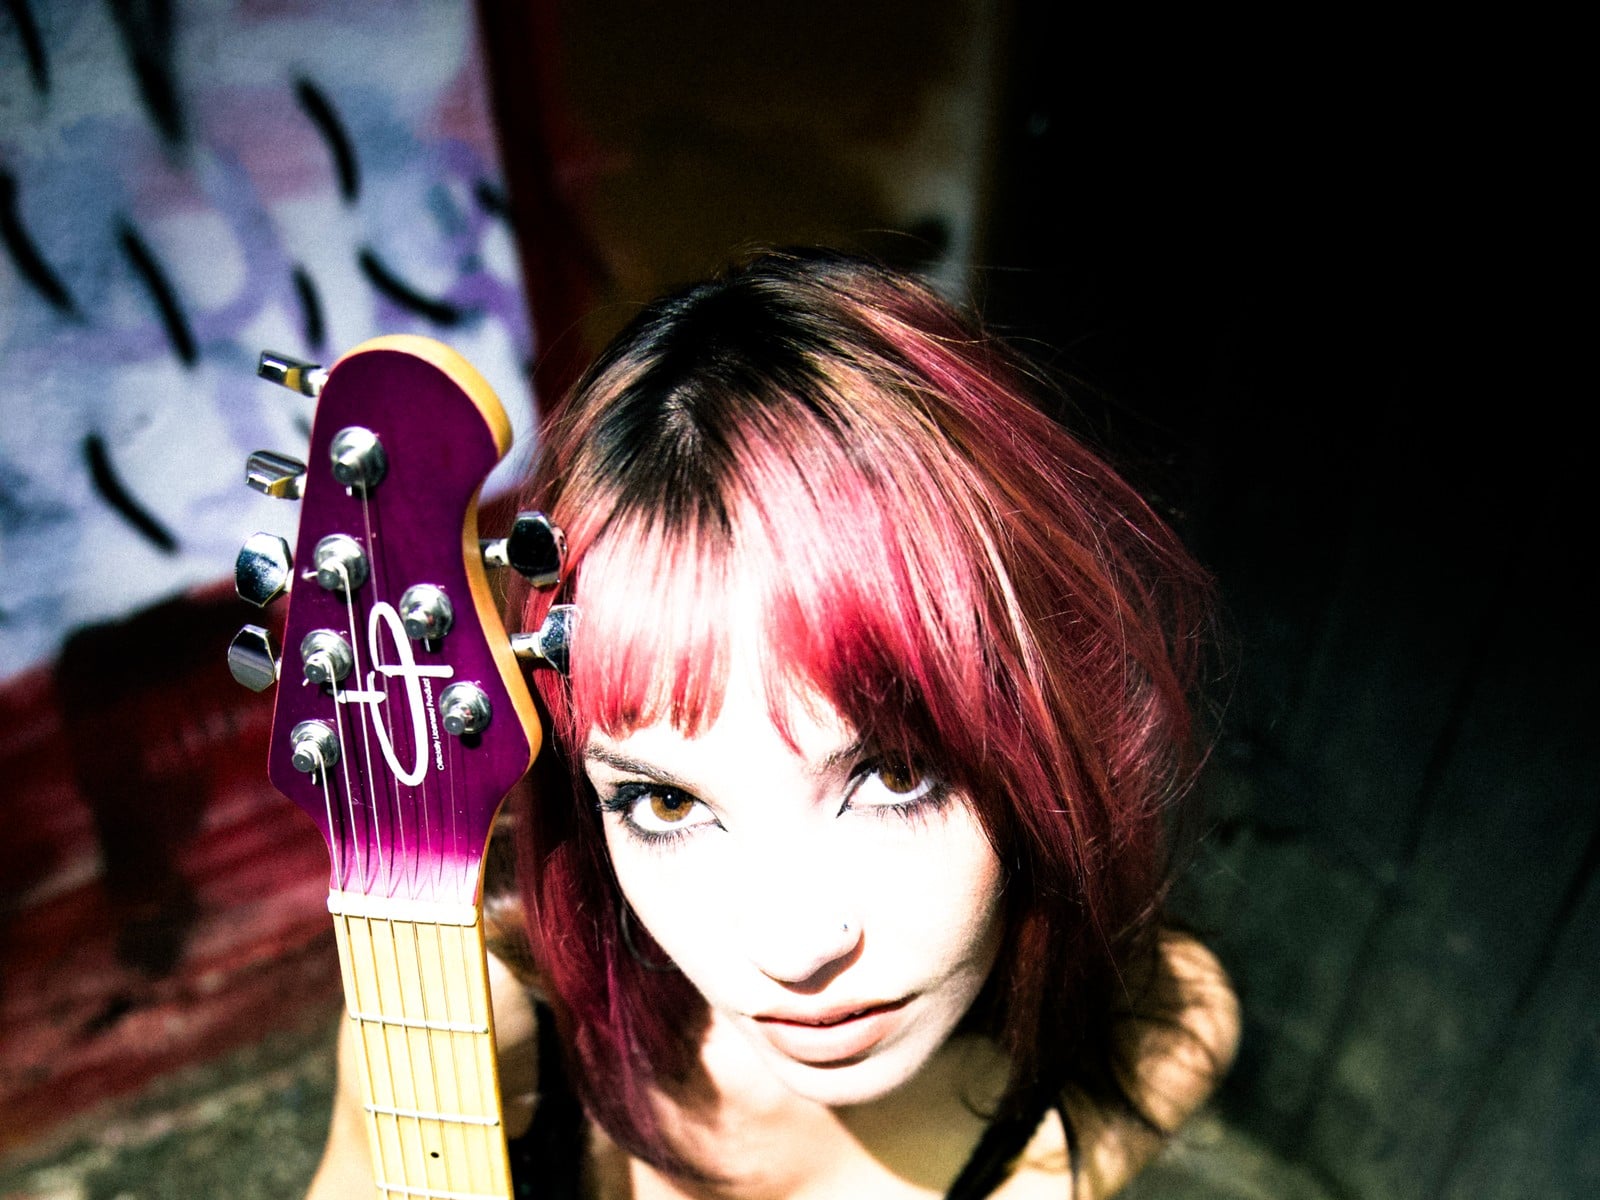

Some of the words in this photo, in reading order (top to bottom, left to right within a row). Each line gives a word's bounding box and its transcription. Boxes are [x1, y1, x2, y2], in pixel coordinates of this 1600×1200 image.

[422, 677, 434, 707] Product
[427, 708, 439, 740] Licensed
[434, 740, 445, 771] Officially
